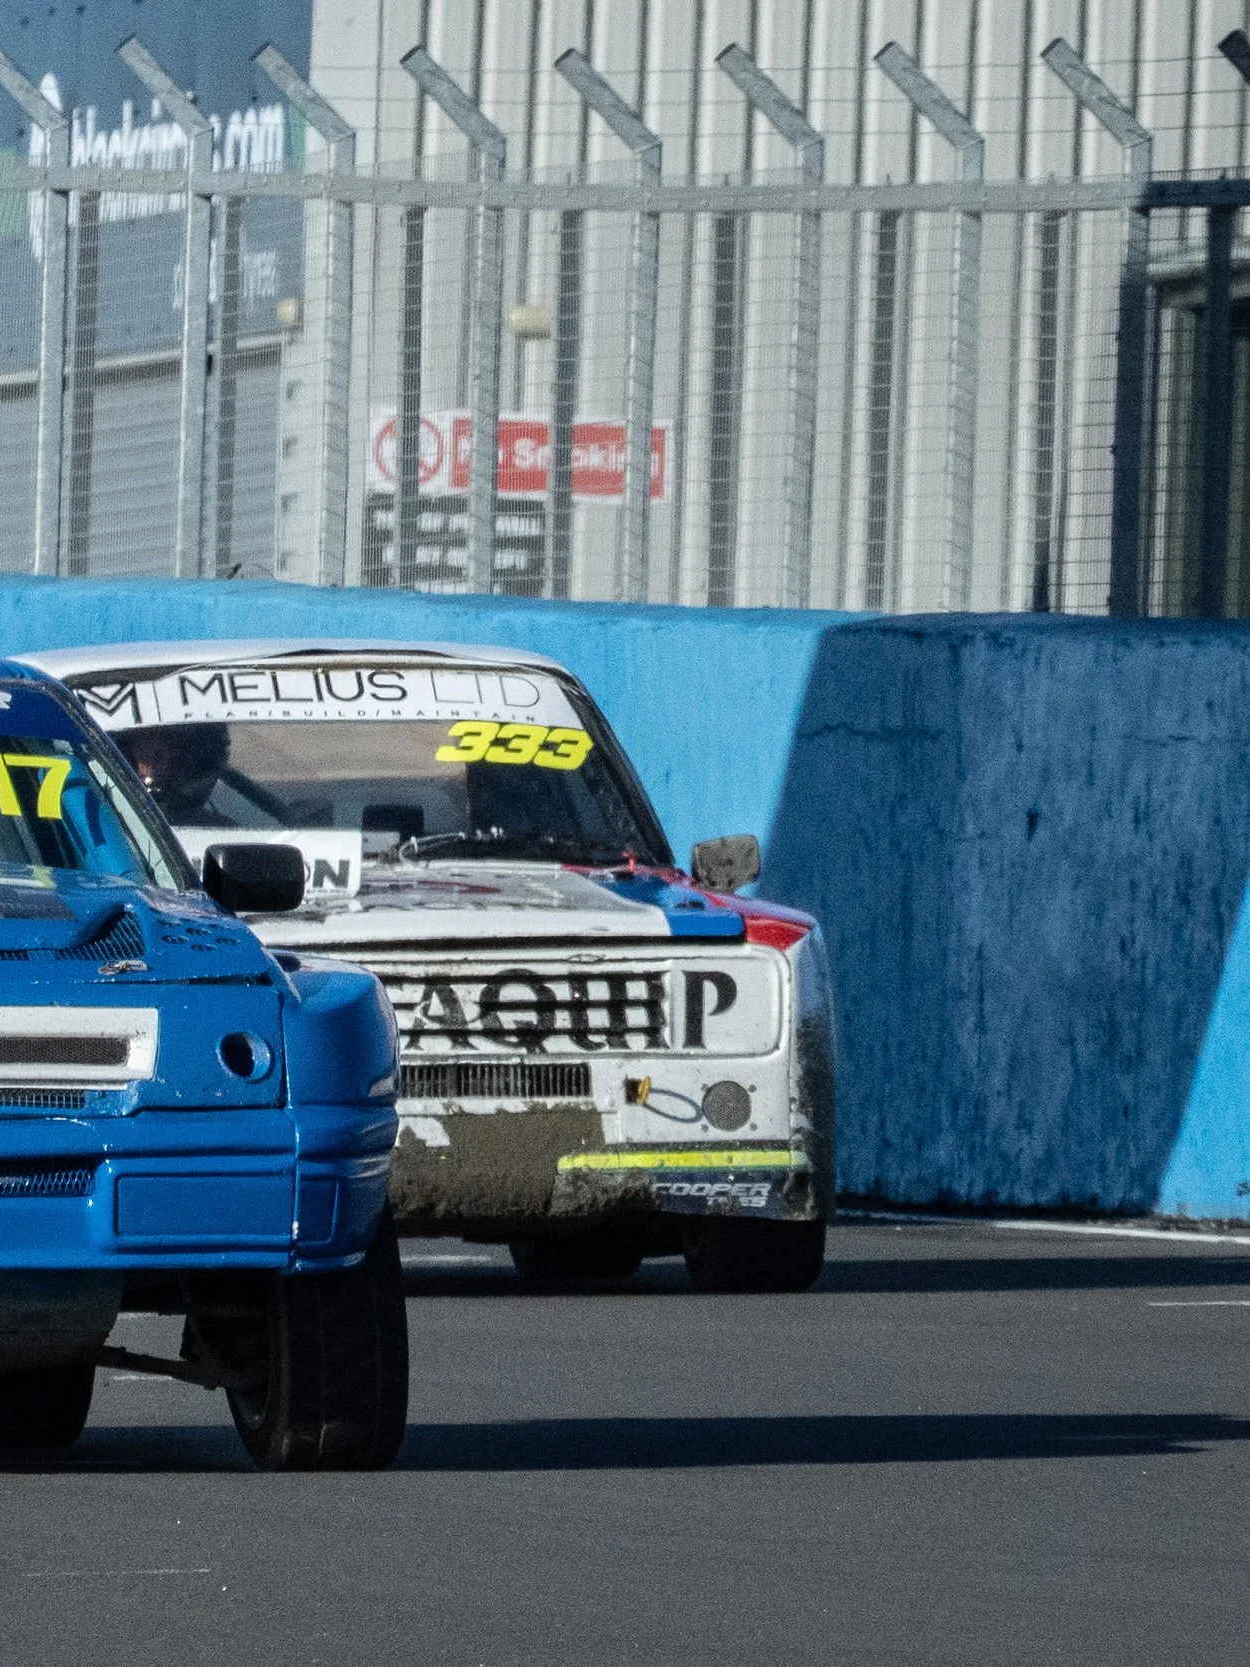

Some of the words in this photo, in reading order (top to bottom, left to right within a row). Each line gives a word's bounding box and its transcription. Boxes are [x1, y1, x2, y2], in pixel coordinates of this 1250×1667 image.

[179, 670, 408, 706] MELIUS
[430, 670, 541, 708] LTD
[434, 720, 594, 771] 333
